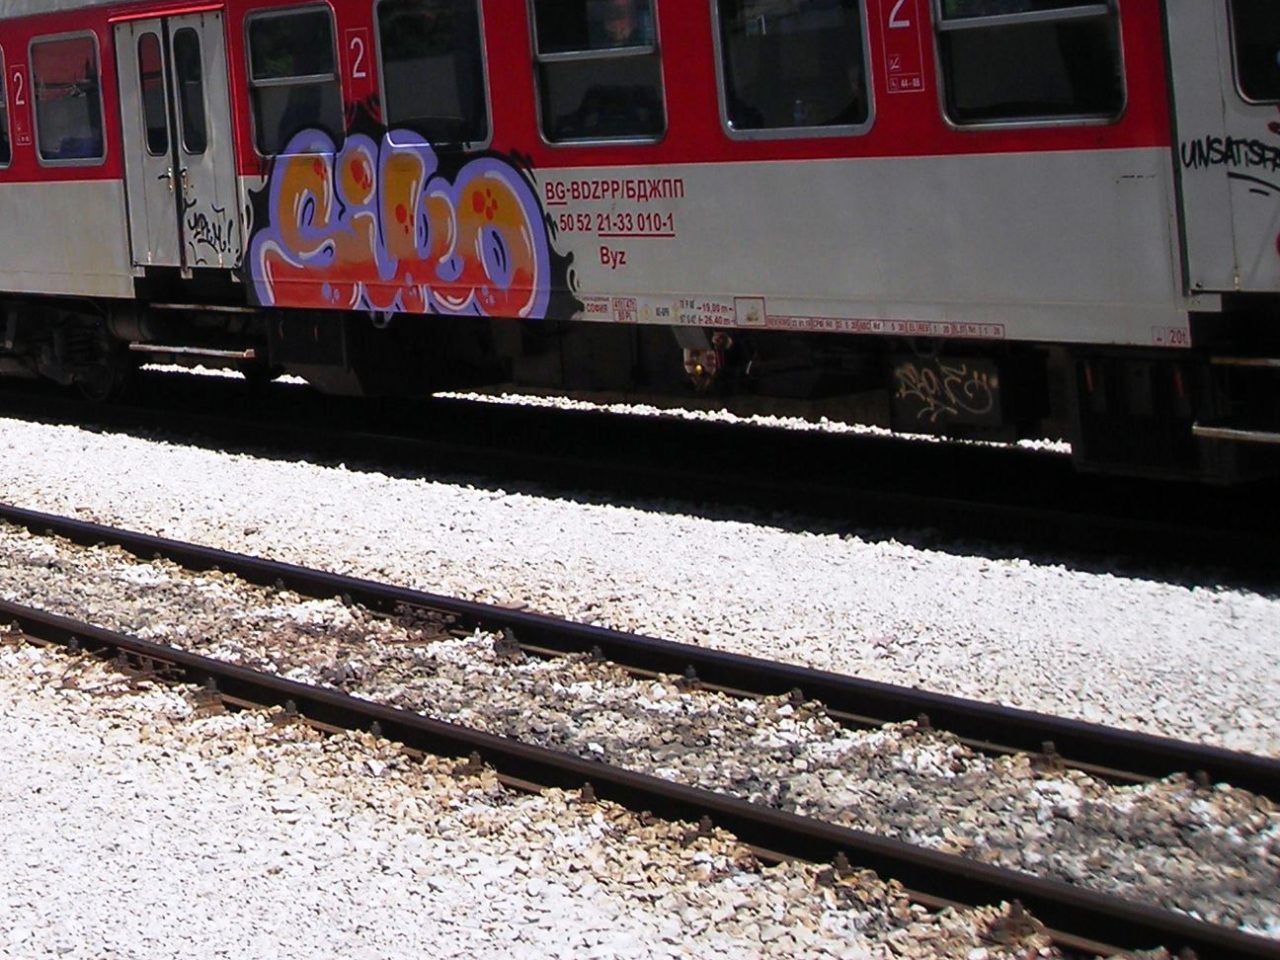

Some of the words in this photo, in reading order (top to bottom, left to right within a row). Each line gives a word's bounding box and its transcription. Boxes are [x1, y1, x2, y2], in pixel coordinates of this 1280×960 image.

[351, 37, 366, 78] 2
[14, 72, 25, 105] 2
[545, 178, 684, 201] BG-BDZPP/БДЖПП
[559, 213, 575, 232] 50
[577, 213, 592, 232] 52
[596, 212, 634, 232] 21-33
[637, 211, 674, 232] 010-1
[600, 246, 626, 270] Byz
